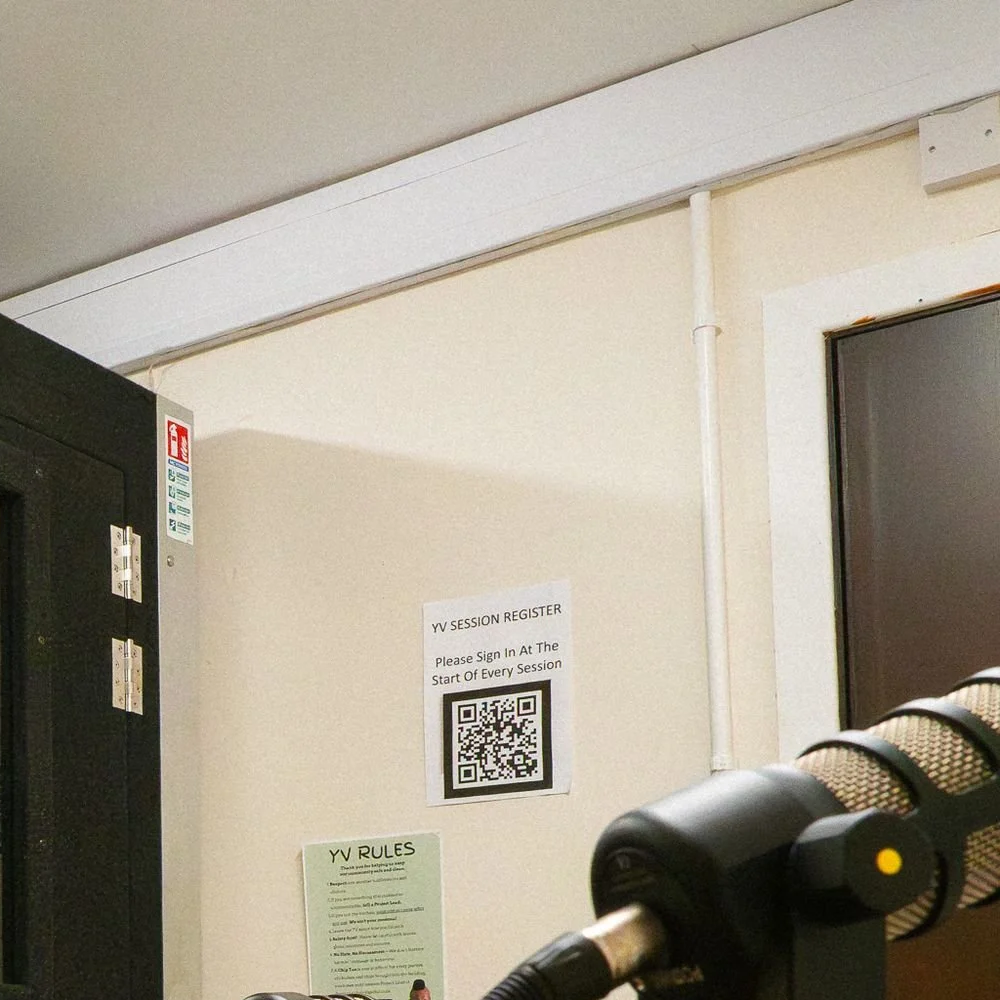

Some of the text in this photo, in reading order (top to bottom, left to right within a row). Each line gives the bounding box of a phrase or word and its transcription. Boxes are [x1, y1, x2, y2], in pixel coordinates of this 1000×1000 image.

[432, 603, 562, 633] YV SESSION REGISTER
[435, 641, 559, 667] Please Sign In At The
[432, 659, 562, 686] Start Of Every Session
[329, 842, 415, 863] YV RULES
